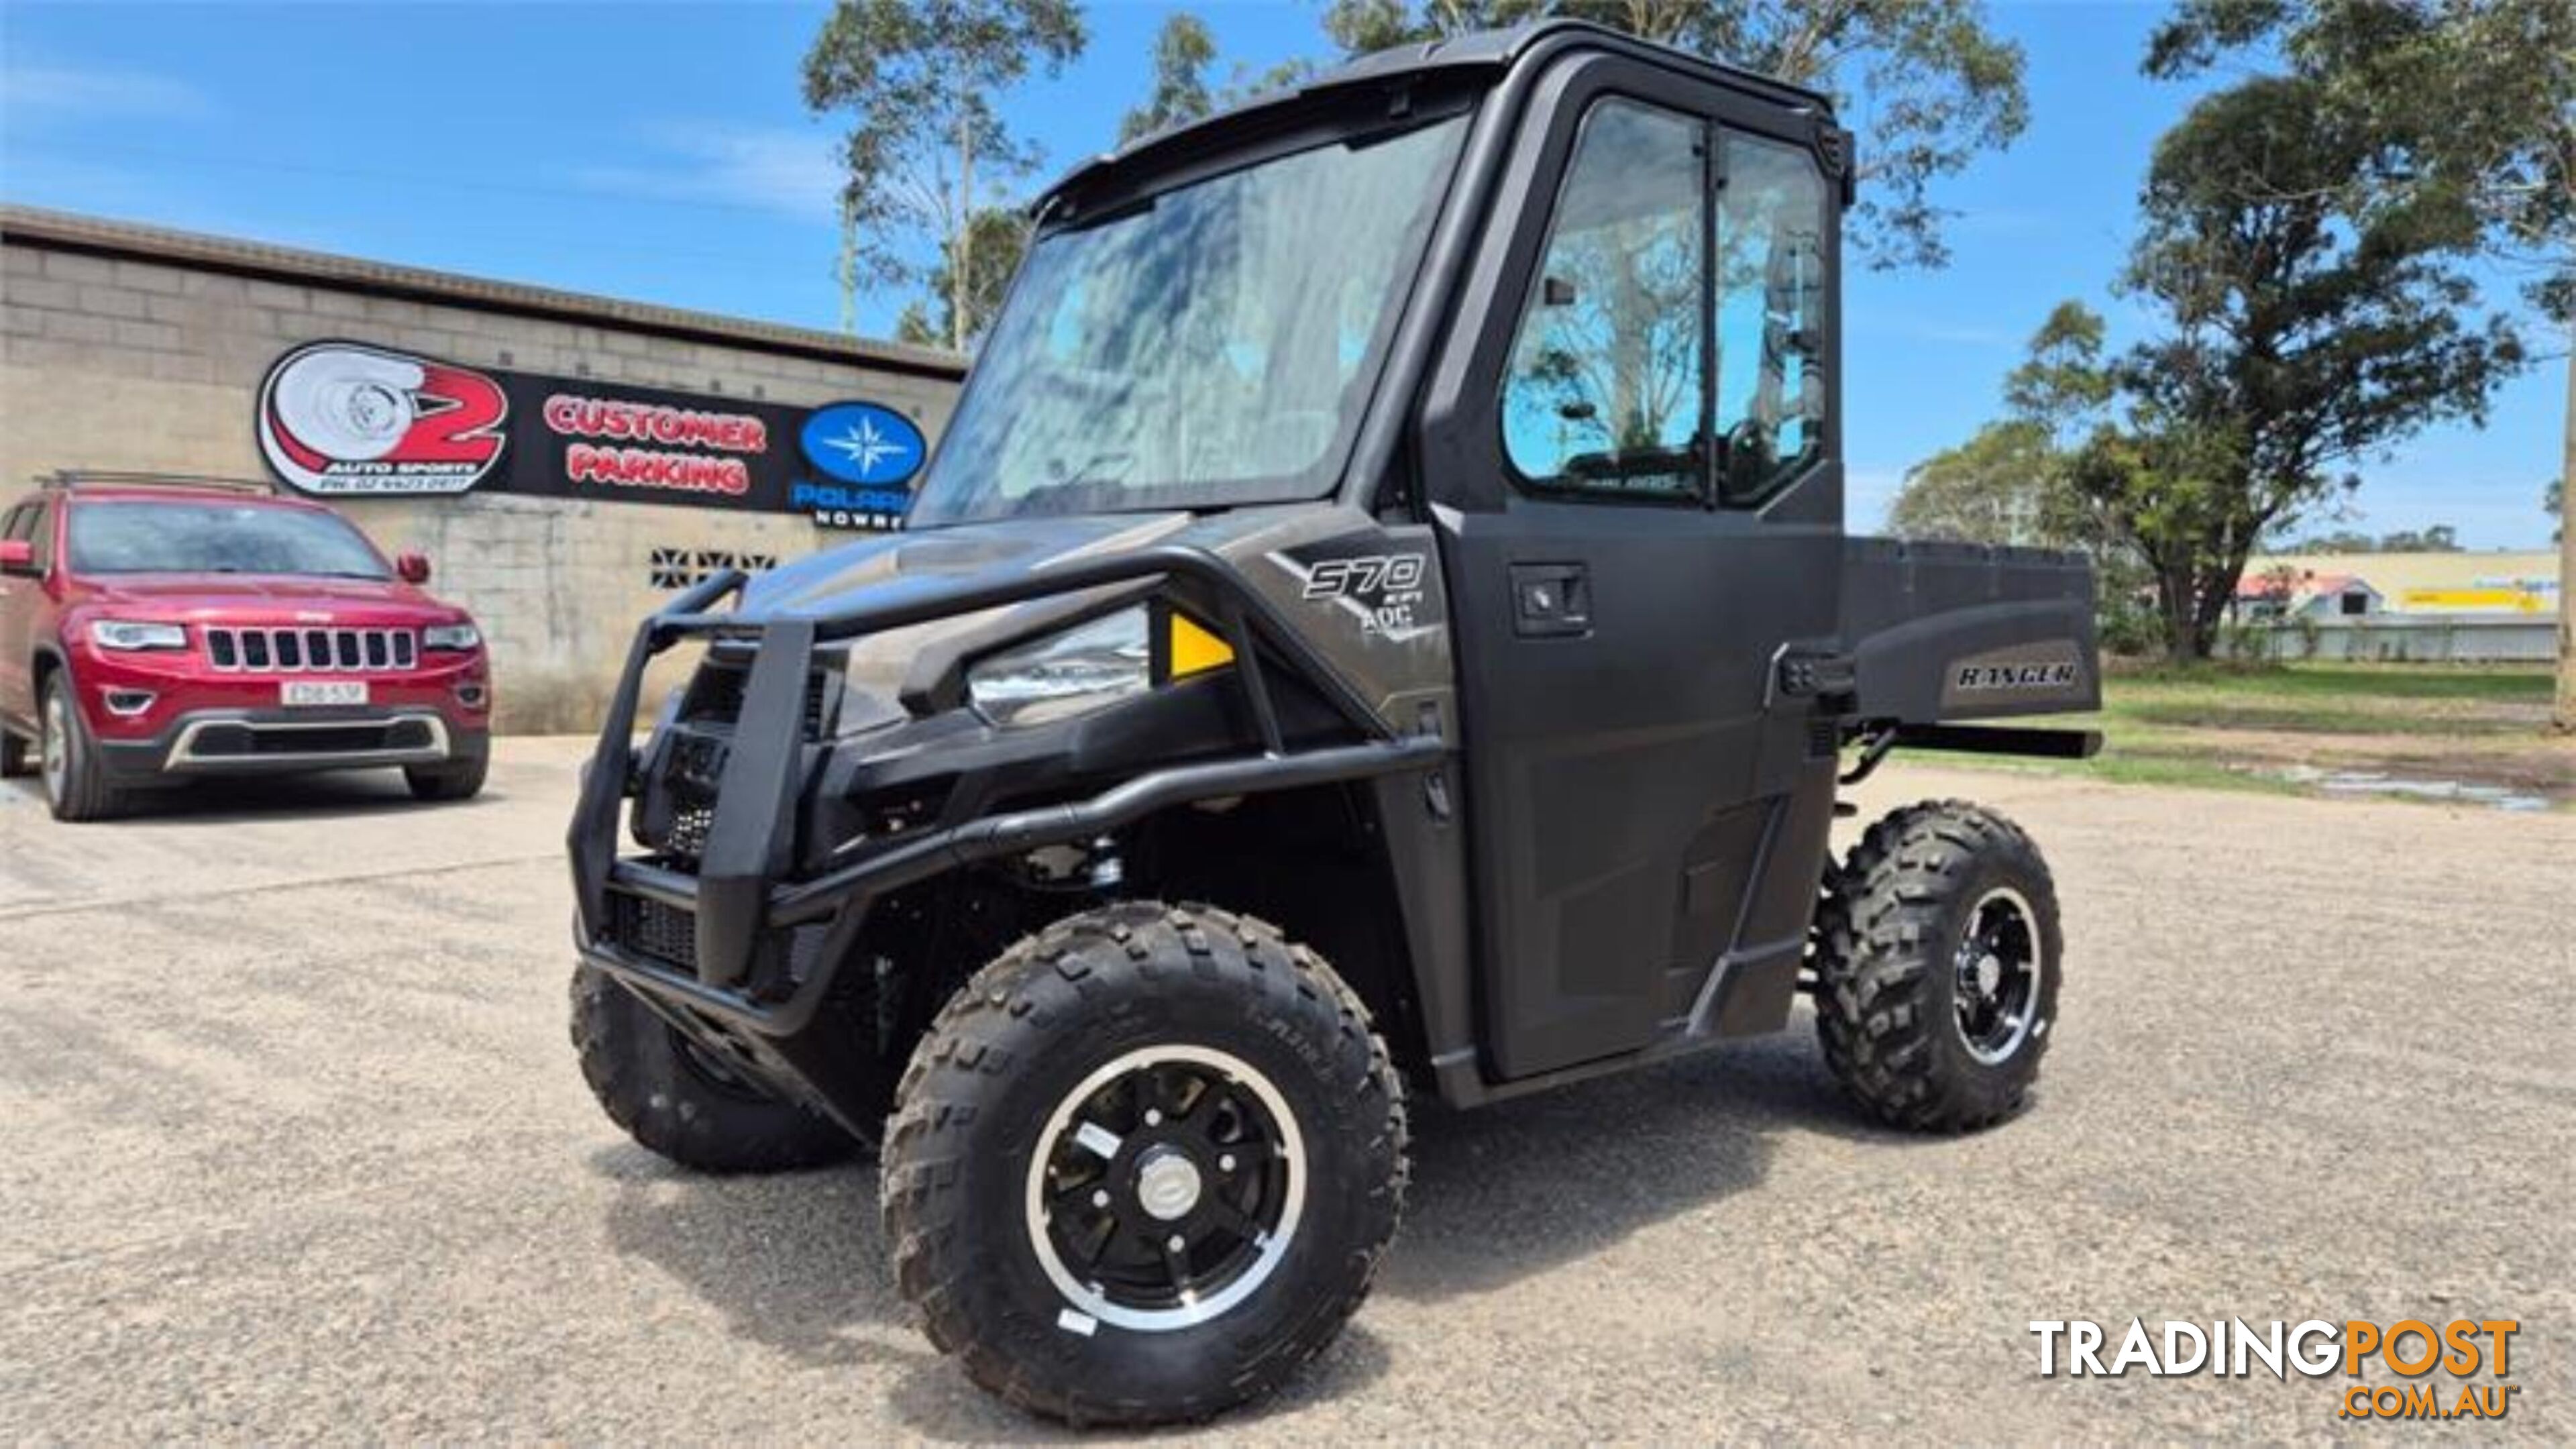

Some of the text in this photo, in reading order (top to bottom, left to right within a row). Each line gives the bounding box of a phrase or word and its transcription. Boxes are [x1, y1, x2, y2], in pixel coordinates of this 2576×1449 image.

[543, 394, 767, 454] CUSTOMER
[325, 461, 478, 474] AUTO SPORTS
[566, 443, 750, 495] PARKING
[1303, 554, 1426, 600] 570
[1956, 663, 2075, 689] RANGER
